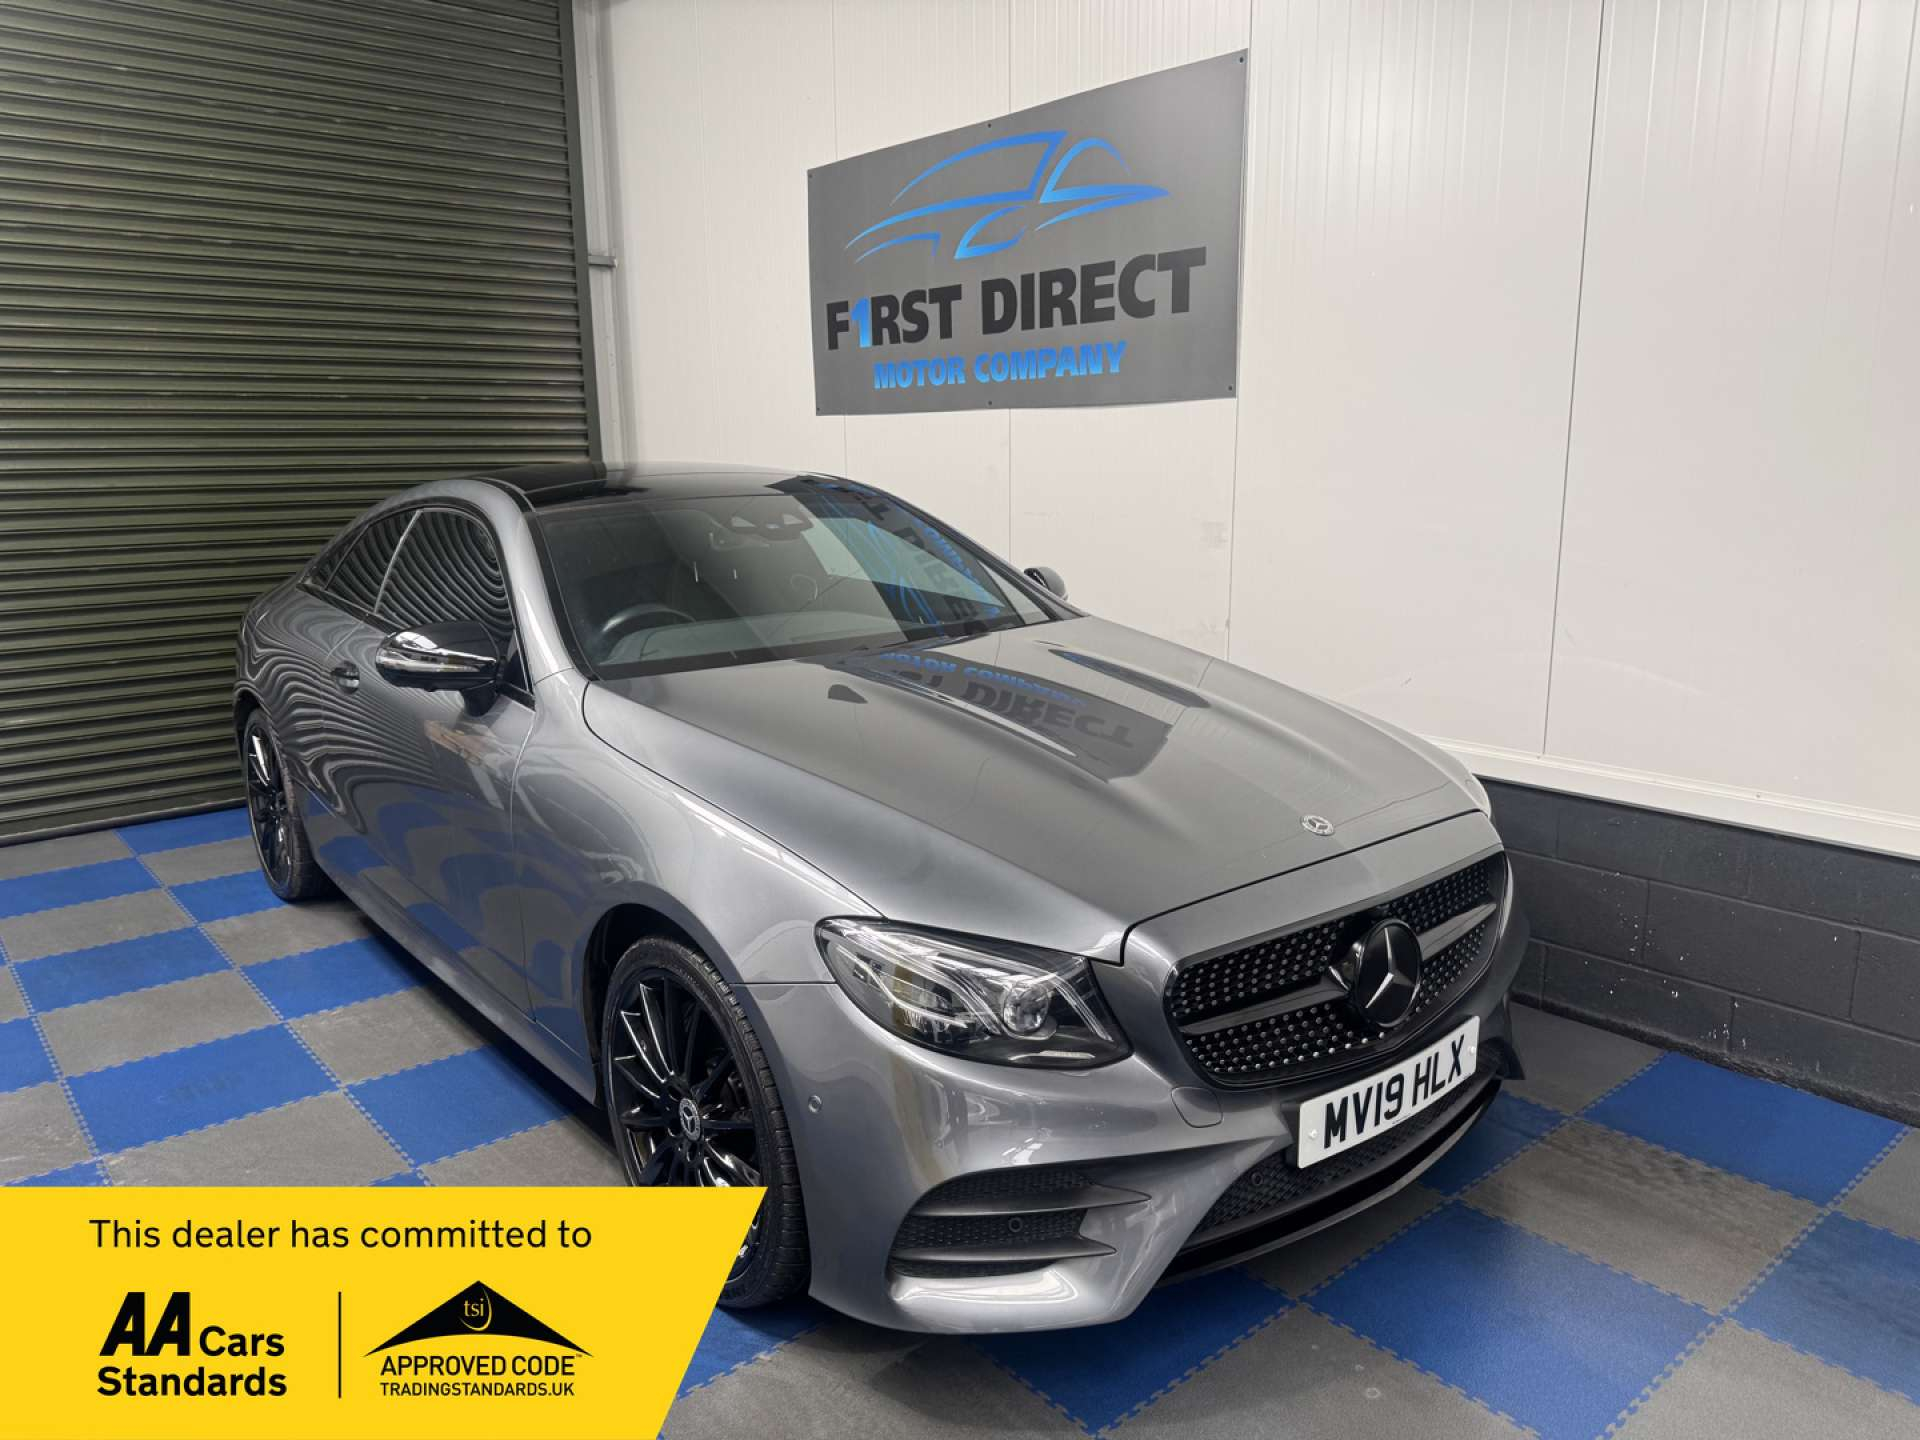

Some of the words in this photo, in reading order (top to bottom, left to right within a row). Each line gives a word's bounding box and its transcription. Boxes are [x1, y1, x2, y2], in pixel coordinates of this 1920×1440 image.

[981, 246, 1207, 335] DIRECT
[873, 356, 966, 389] MOTOR
[973, 340, 1127, 382] COMPANY
[1324, 1073, 1405, 1149] MV19
[1412, 1034, 1465, 1107] HLX
